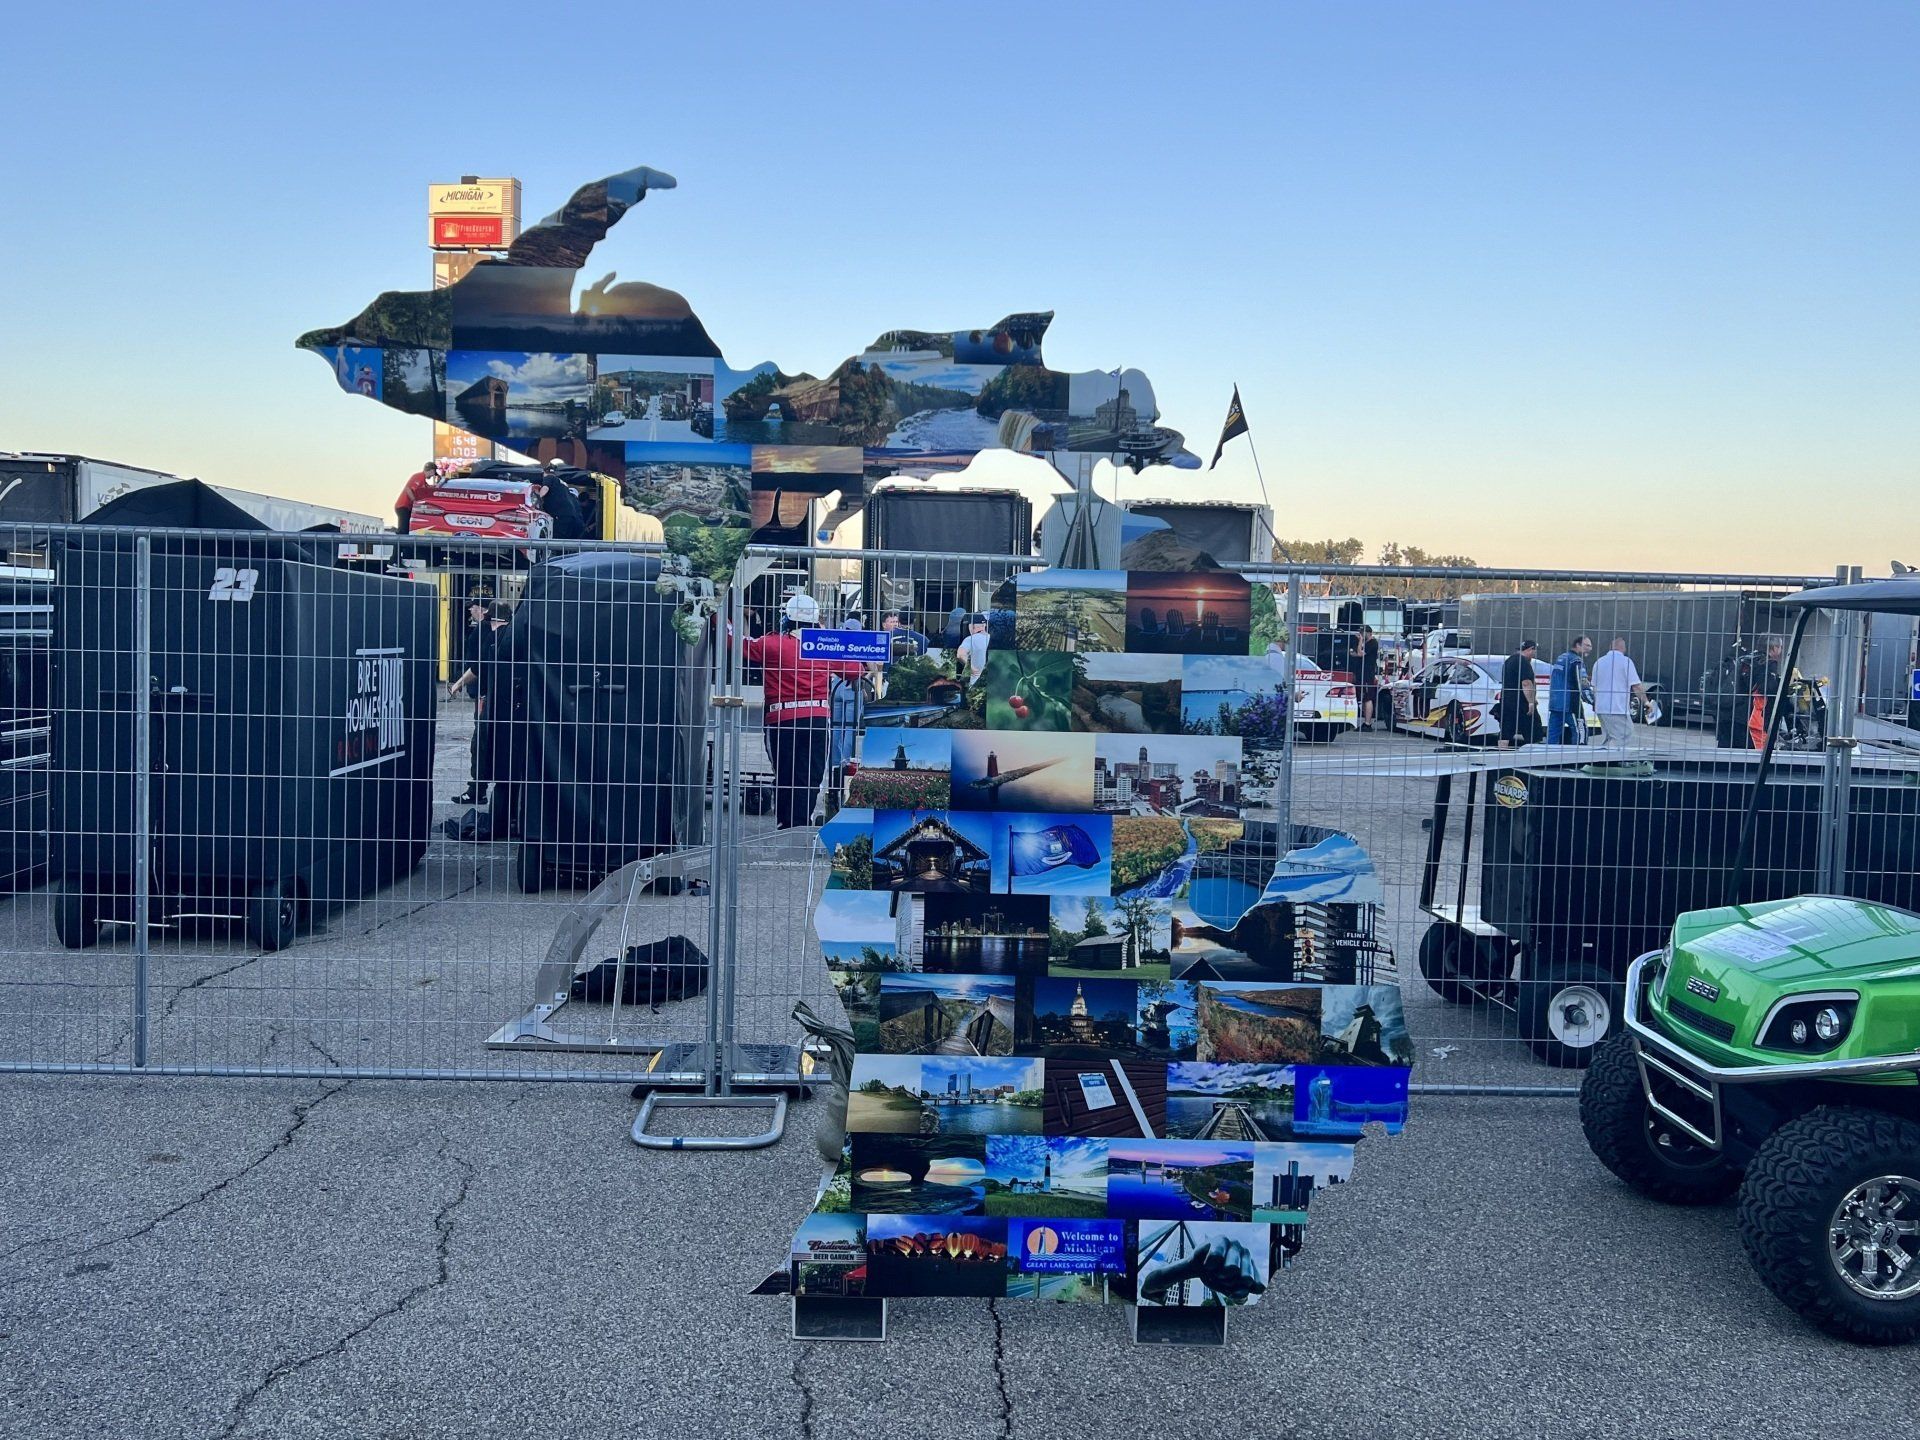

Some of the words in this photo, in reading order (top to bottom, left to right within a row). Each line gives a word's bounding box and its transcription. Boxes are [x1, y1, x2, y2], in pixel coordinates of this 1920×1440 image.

[446, 190, 484, 201] MICHIGAN
[433, 491, 469, 499] GENERAL
[456, 516, 483, 526] ICON
[208, 567, 260, 601] 23
[816, 643, 846, 652] Onsite
[847, 644, 886, 653] Services
[345, 696, 381, 734] HOLMES
[1335, 939, 1360, 947] VEHICLE
[1362, 940, 1377, 948] CITY
[1061, 1231, 1105, 1241] Welcome
[1109, 1232, 1118, 1241] to
[807, 1240, 862, 1251] Budweiser
[1064, 1243, 1116, 1256] Michigan
